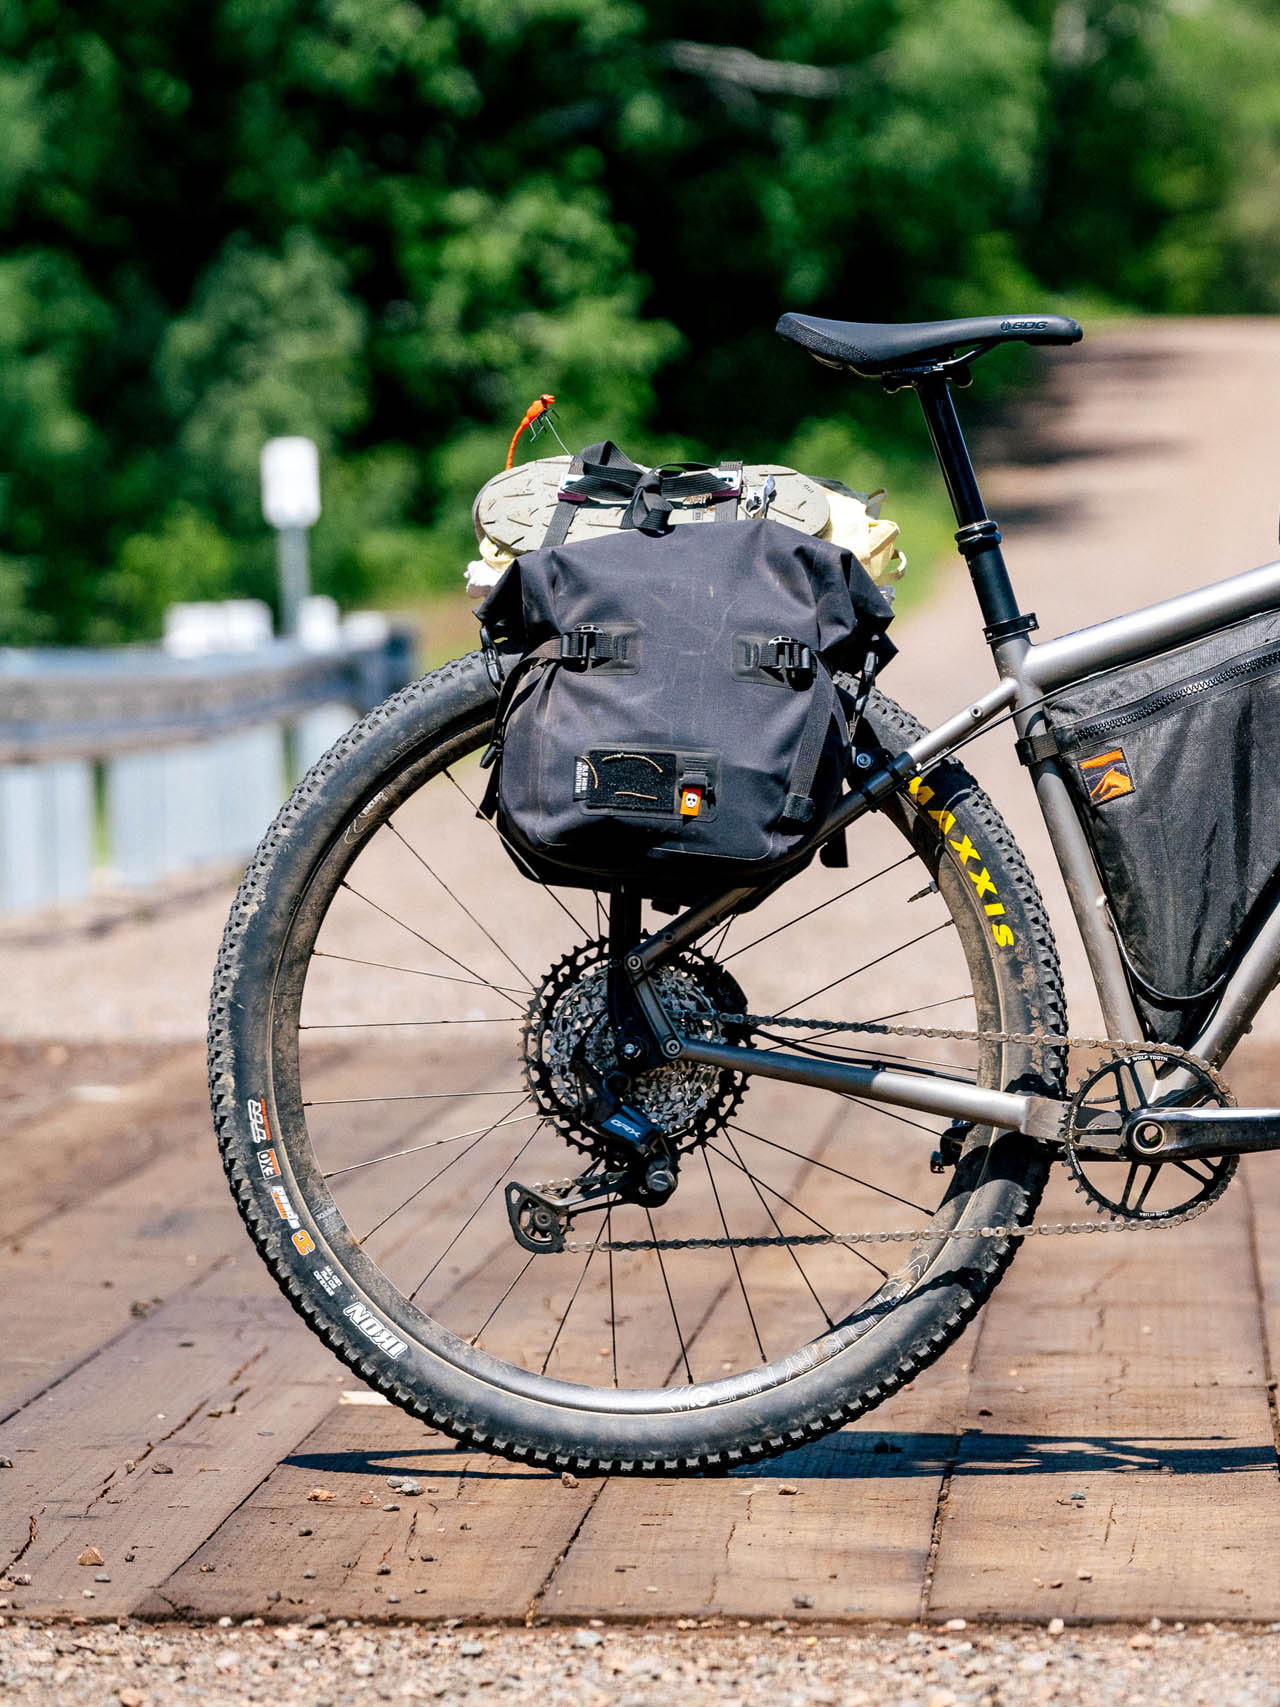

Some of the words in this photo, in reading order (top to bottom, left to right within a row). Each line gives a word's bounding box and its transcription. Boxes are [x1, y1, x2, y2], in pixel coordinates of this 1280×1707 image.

[906, 775, 1014, 947] MAXXIS
[247, 1099, 267, 1143] TR
[610, 1119, 641, 1138] GRX
[257, 1150, 276, 1180] EXO
[292, 1229, 315, 1255] 3C
[343, 1301, 409, 1360] IKON
